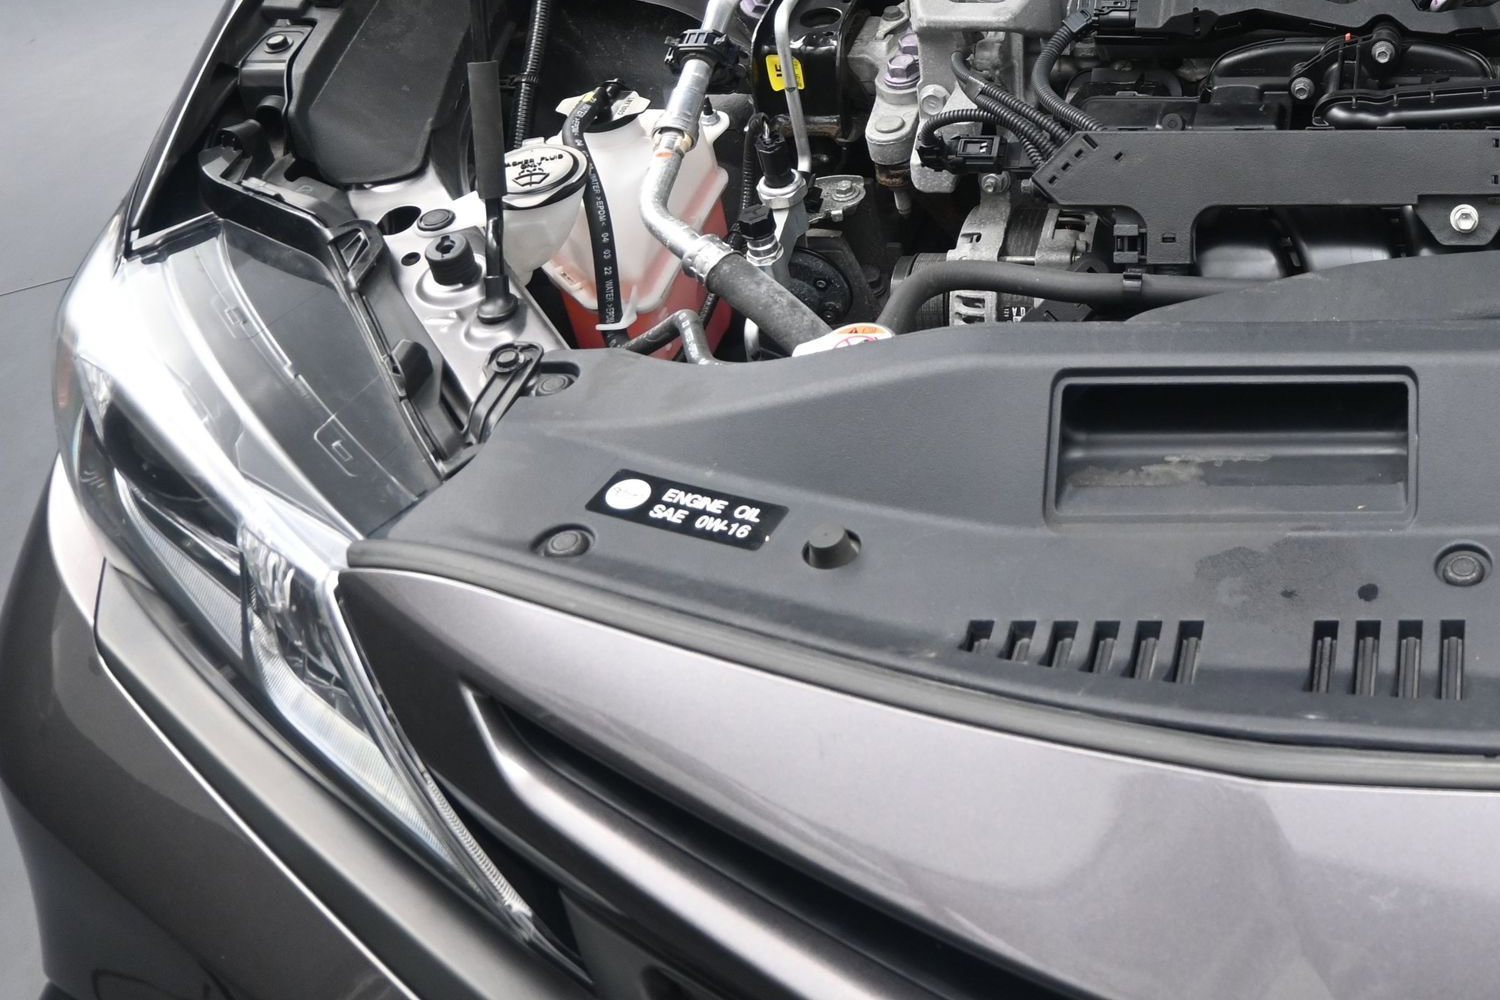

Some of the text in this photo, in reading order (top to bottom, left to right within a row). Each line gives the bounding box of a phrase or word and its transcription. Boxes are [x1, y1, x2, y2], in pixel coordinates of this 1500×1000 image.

[540, 153, 564, 162] FLUID
[589, 174, 601, 195] WATER
[601, 232, 610, 243] 04
[602, 249, 612, 260] 03
[603, 266, 613, 276] 22
[604, 280, 615, 303] WATER
[661, 487, 761, 523] ENGINE OIL
[648, 503, 752, 538] SAE 0W-16
